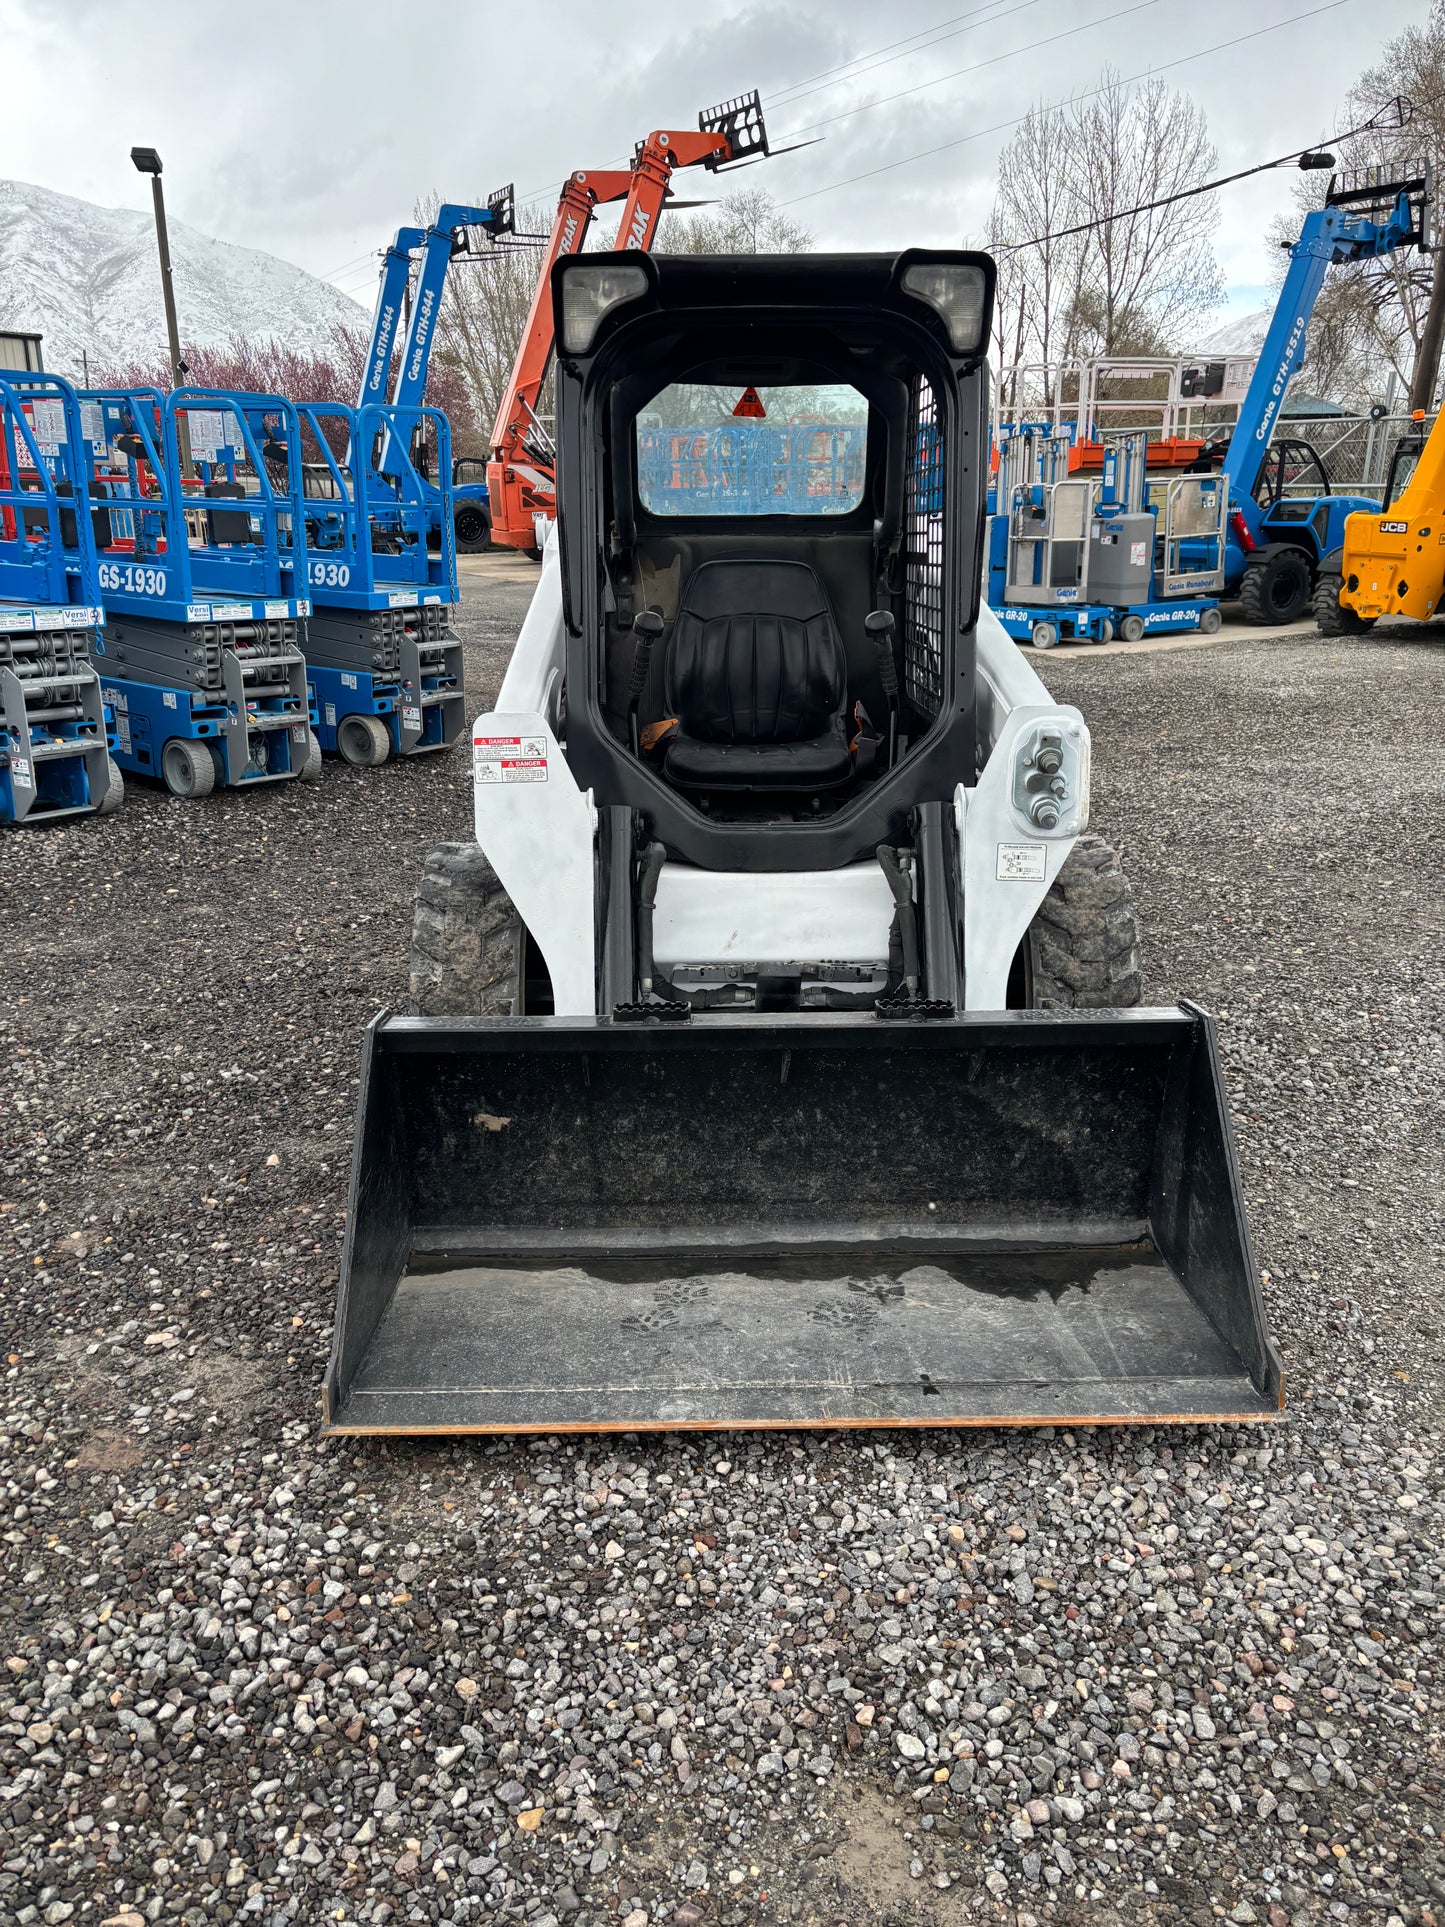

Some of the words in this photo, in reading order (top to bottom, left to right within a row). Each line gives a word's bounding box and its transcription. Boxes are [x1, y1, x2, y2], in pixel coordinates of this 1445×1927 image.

[376, 304, 395, 358] GTH-844
[407, 348, 424, 382] Genie
[416, 288, 436, 346] GTH-844
[369, 359, 384, 391] Genie
[1255, 400, 1277, 441] Genie
[1272, 315, 1305, 397] GTH-5519
[1105, 522, 1124, 532] Genie
[1380, 522, 1407, 533] JCB
[98, 564, 166, 596] GS-1930
[1056, 587, 1077, 597] Genie
[65, 609, 87, 618] Versi
[188, 604, 209, 613] Versi
[992, 609, 1005, 619] nie
[1005, 610, 1028, 621] GR-20
[1149, 611, 1171, 622] Genie
[1171, 609, 1196, 621] GR-20
